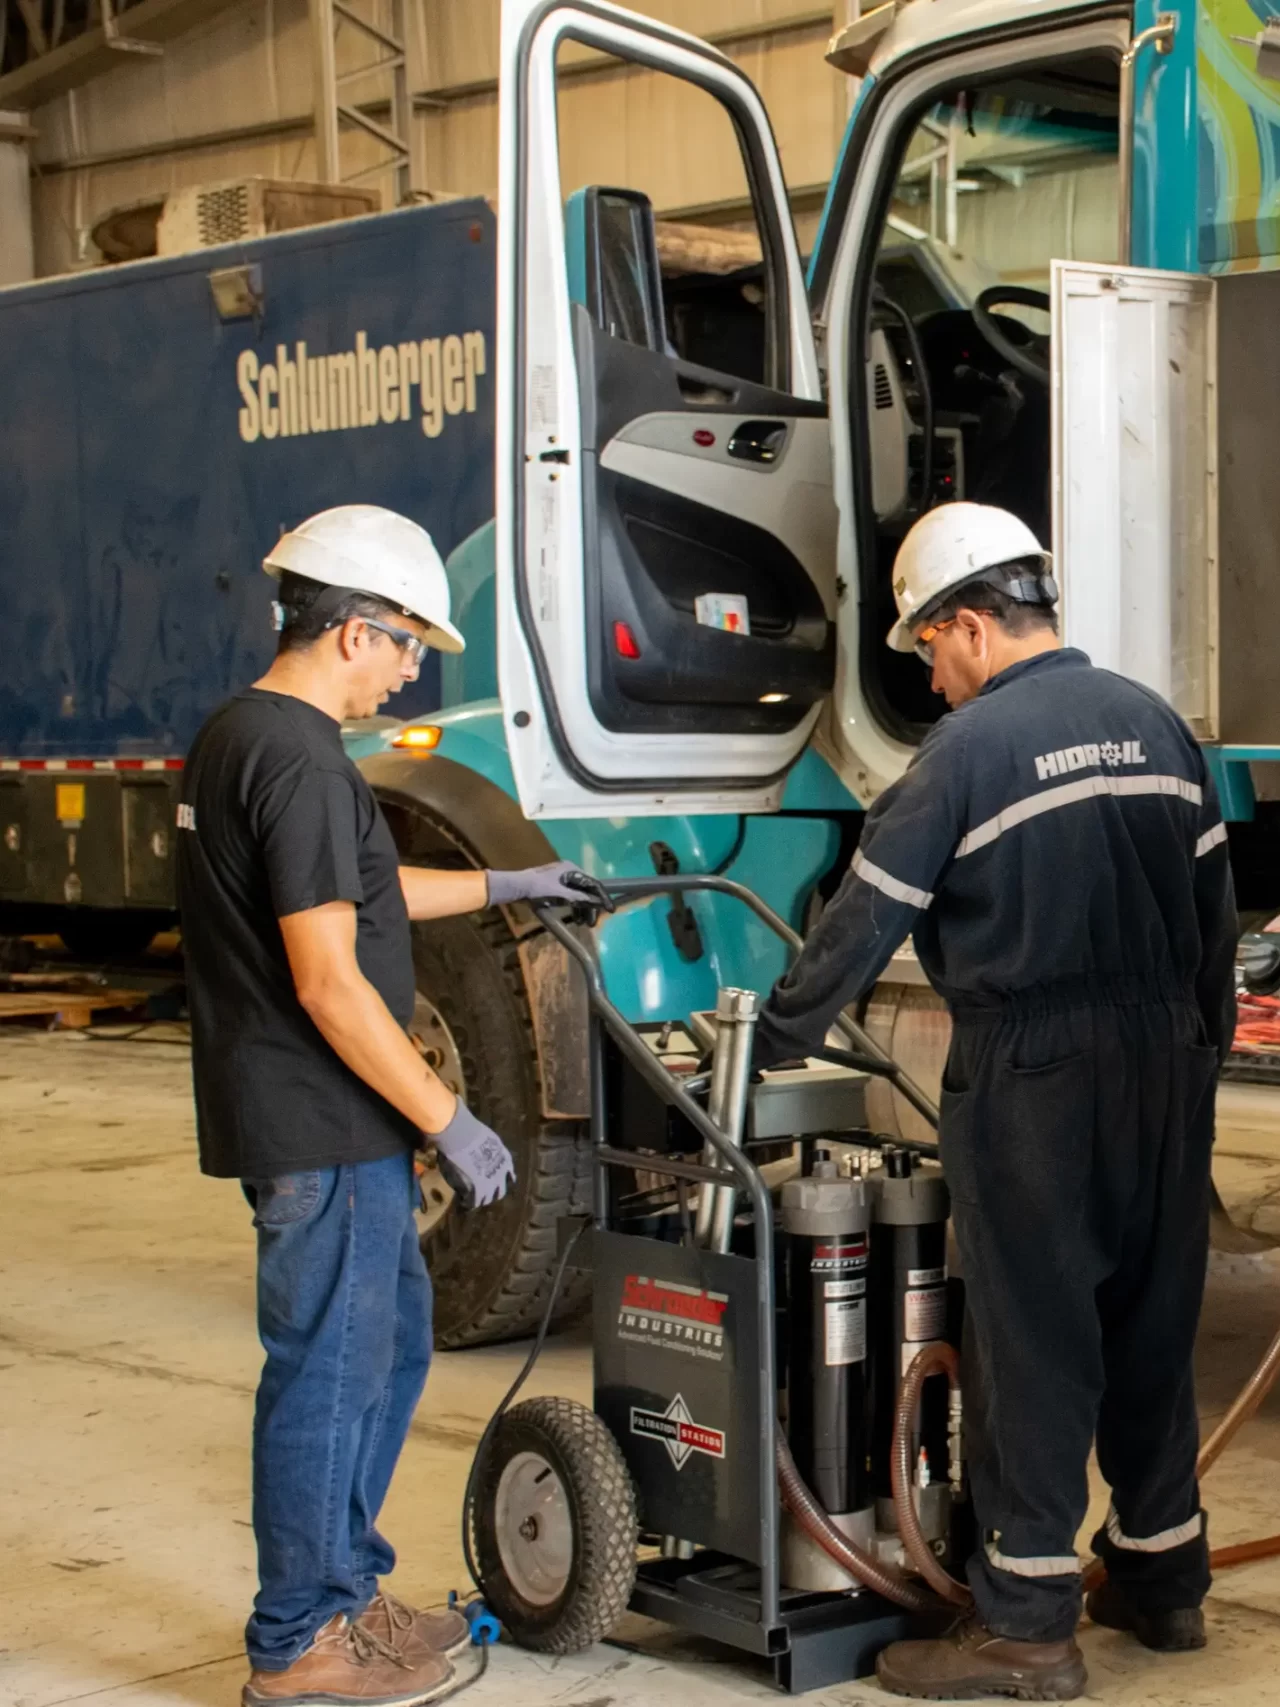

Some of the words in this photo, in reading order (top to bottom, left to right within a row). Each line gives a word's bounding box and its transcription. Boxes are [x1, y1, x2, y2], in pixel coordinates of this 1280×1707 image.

[237, 330, 486, 442] Schlumberger
[1034, 741, 1146, 780] HIDROIL
[621, 1274, 727, 1326] Schroeder
[618, 1313, 723, 1347] INDUSTRIES
[634, 1416, 678, 1436] FILTRATION
[681, 1428, 721, 1447] STATION
